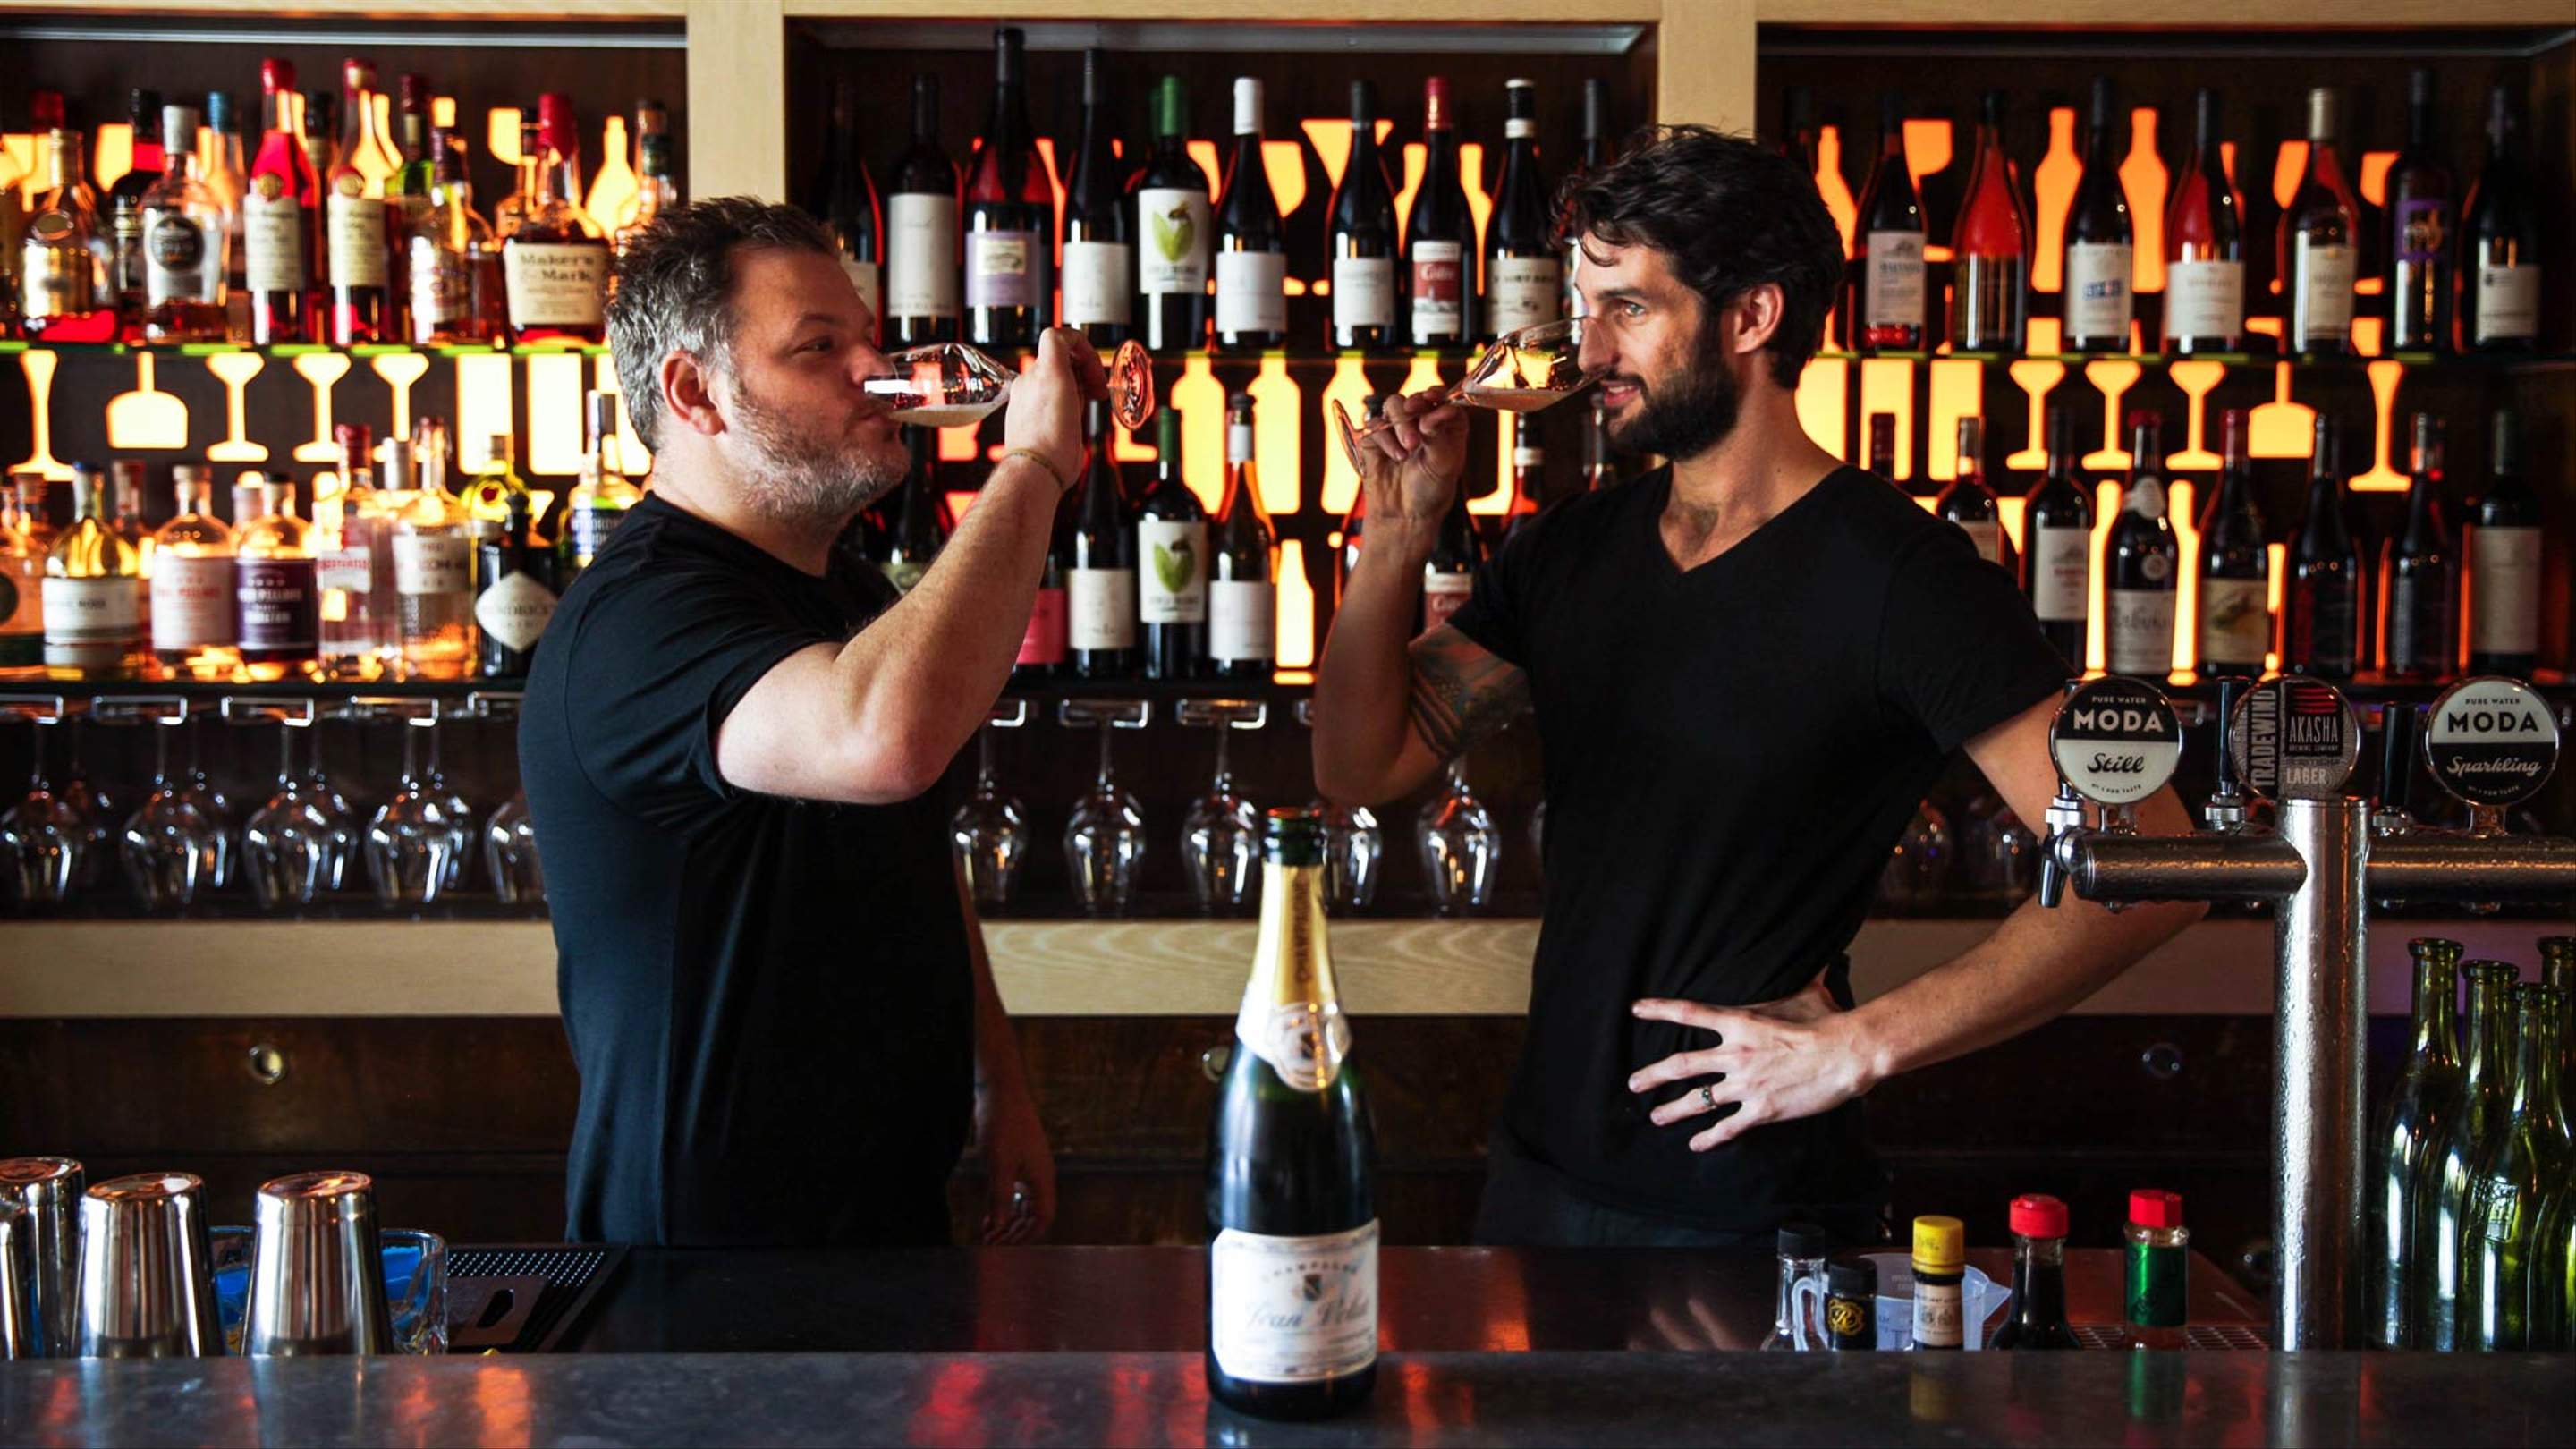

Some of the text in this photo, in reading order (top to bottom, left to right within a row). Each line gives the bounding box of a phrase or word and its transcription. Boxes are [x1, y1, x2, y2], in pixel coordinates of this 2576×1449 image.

[541, 269, 592, 282] Mark
[2092, 696, 2146, 704] PURE WATER
[2073, 709, 2164, 733] MODA
[2290, 716, 2339, 743] AKASHA
[2448, 711, 2539, 733] MODA
[2250, 690, 2276, 786] TRADEWIND
[2087, 752, 2145, 773] Still
[2446, 756, 2542, 777] Sparkling
[2286, 767, 2326, 784] LAGER
